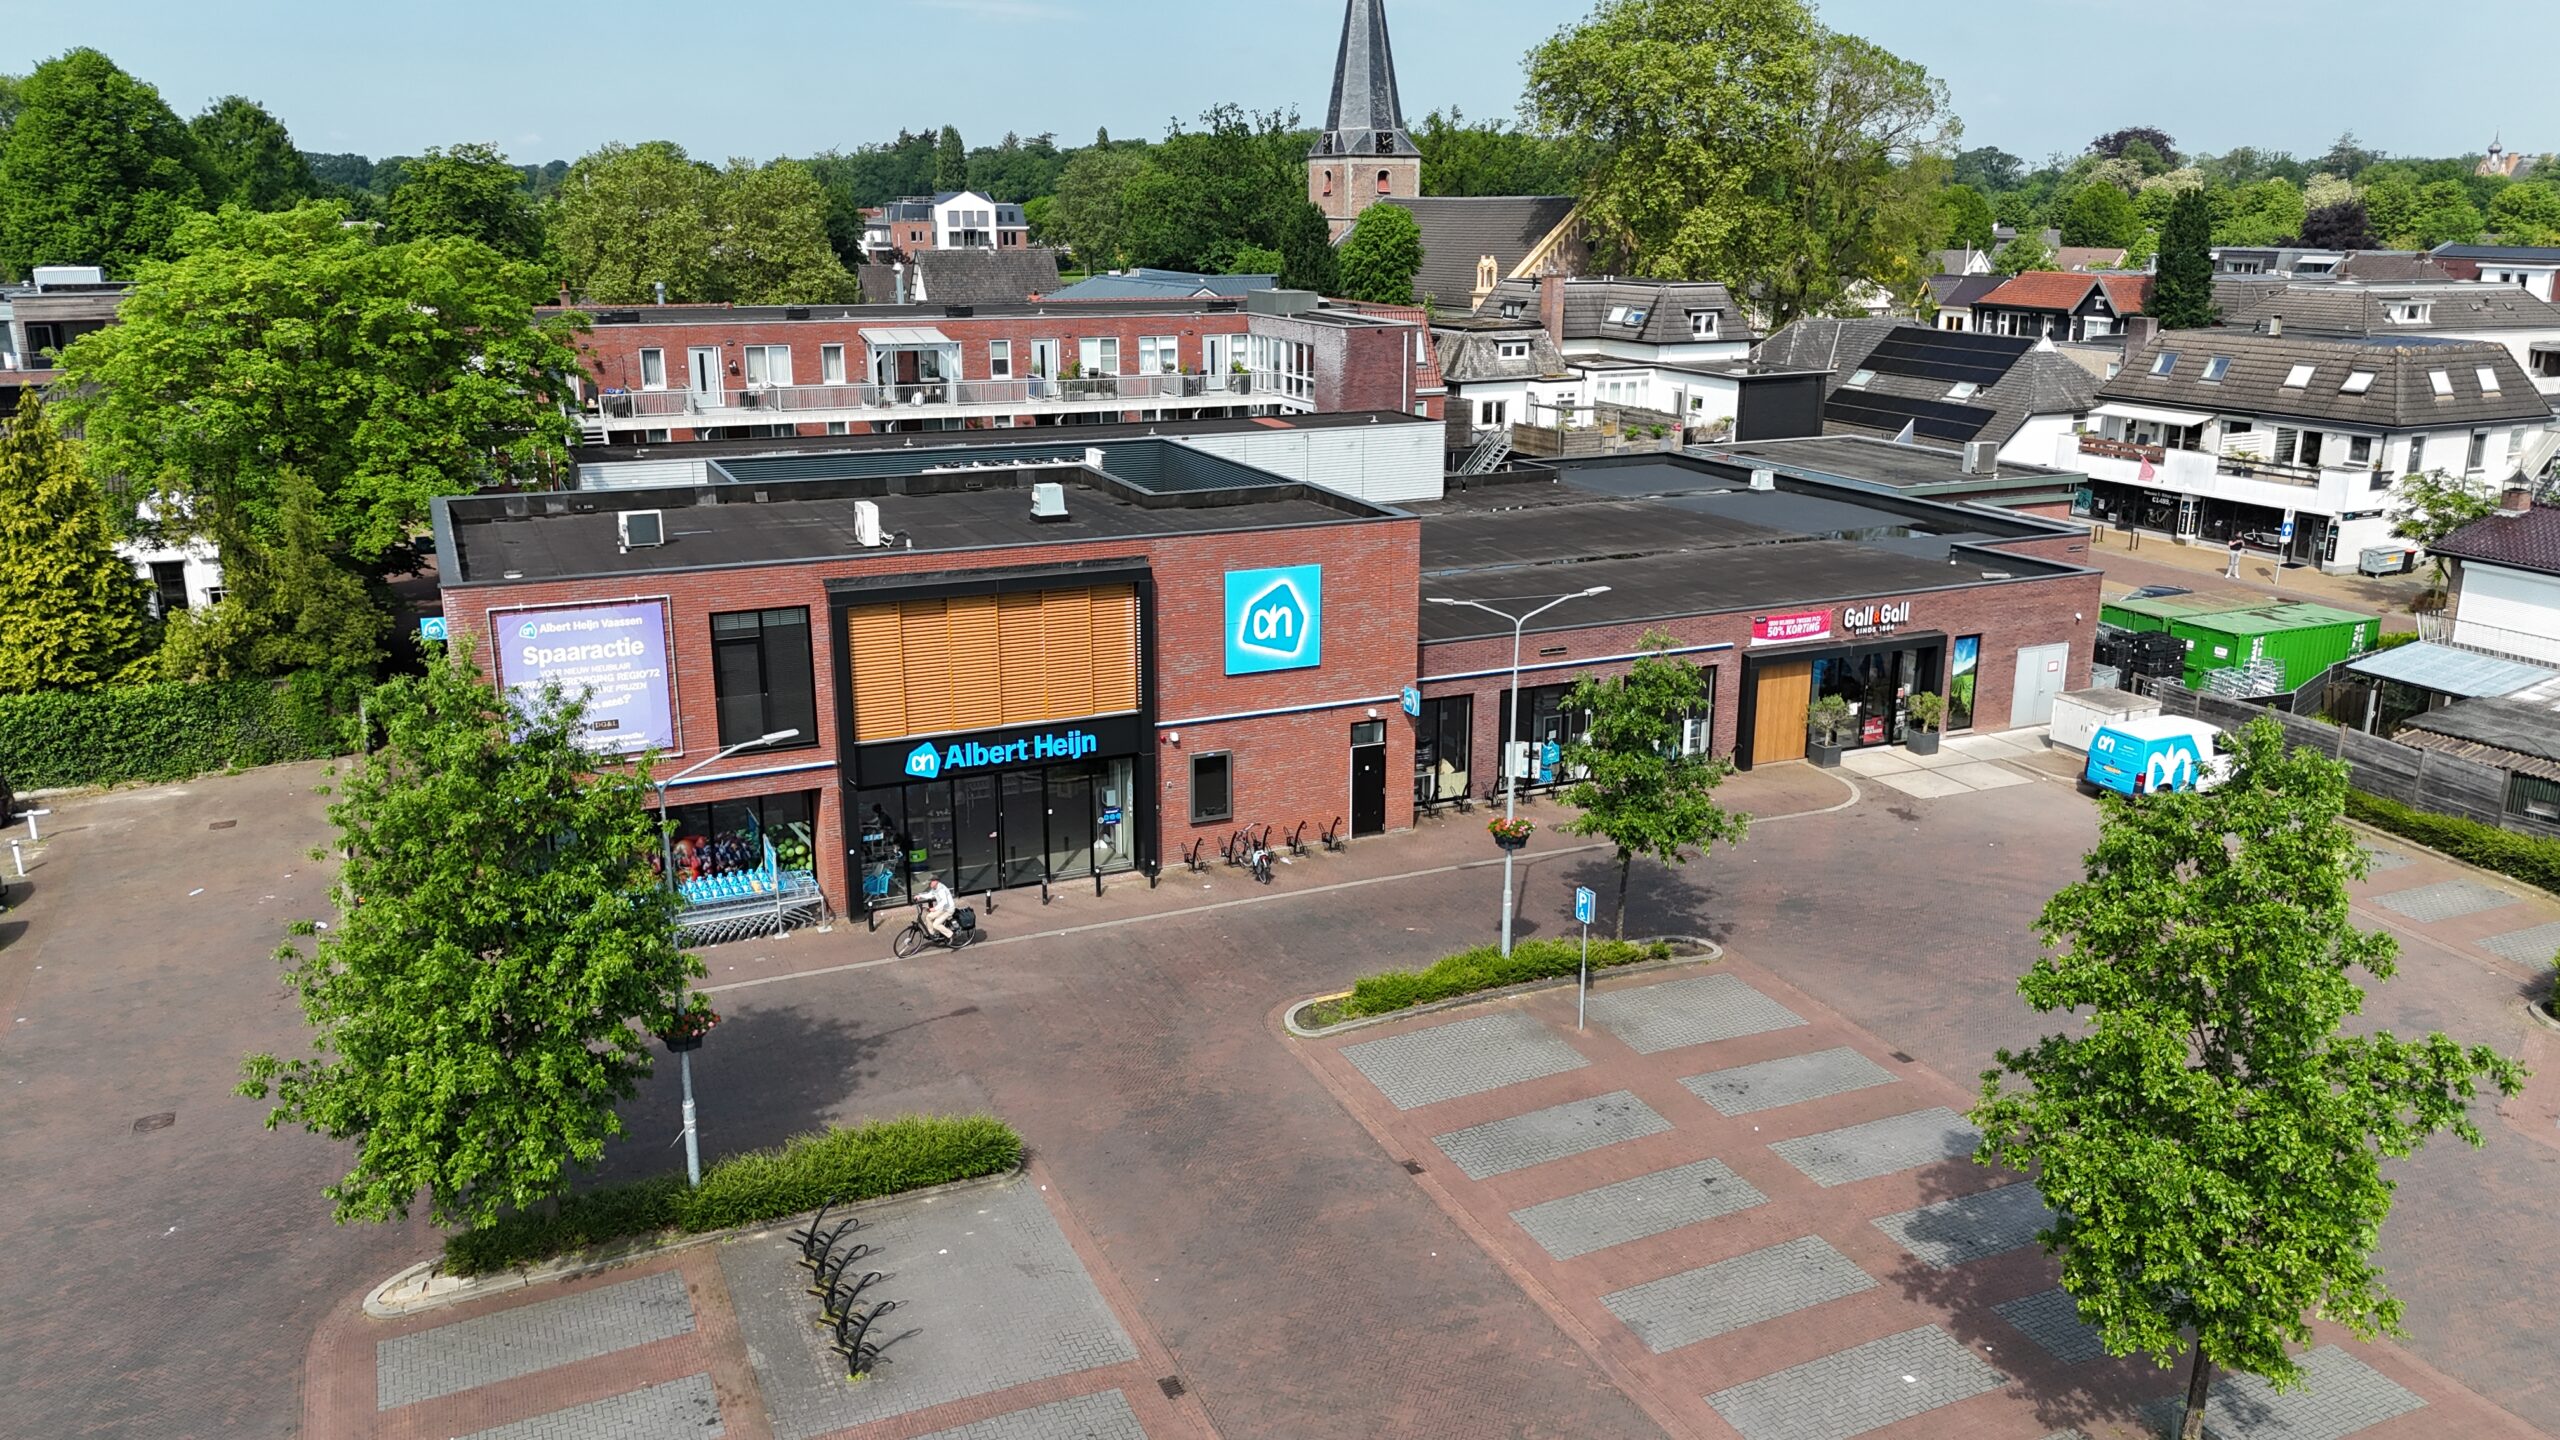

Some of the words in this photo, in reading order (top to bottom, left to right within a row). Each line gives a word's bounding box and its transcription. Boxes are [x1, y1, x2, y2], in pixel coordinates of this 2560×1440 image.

[540, 622, 571, 633] Albert
[573, 620, 599, 631] Heijn
[601, 617, 643, 628] Vaassen
[1767, 626, 1785, 637] 50%
[1786, 621, 1820, 635] KORTING
[1855, 626, 1876, 635] SINDS
[522, 637, 645, 668] Spaaractie
[564, 666, 590, 675] NIEUW
[944, 739, 1028, 770] Albert
[1034, 730, 1097, 760] Heijn
[1579, 892, 1587, 908] P
